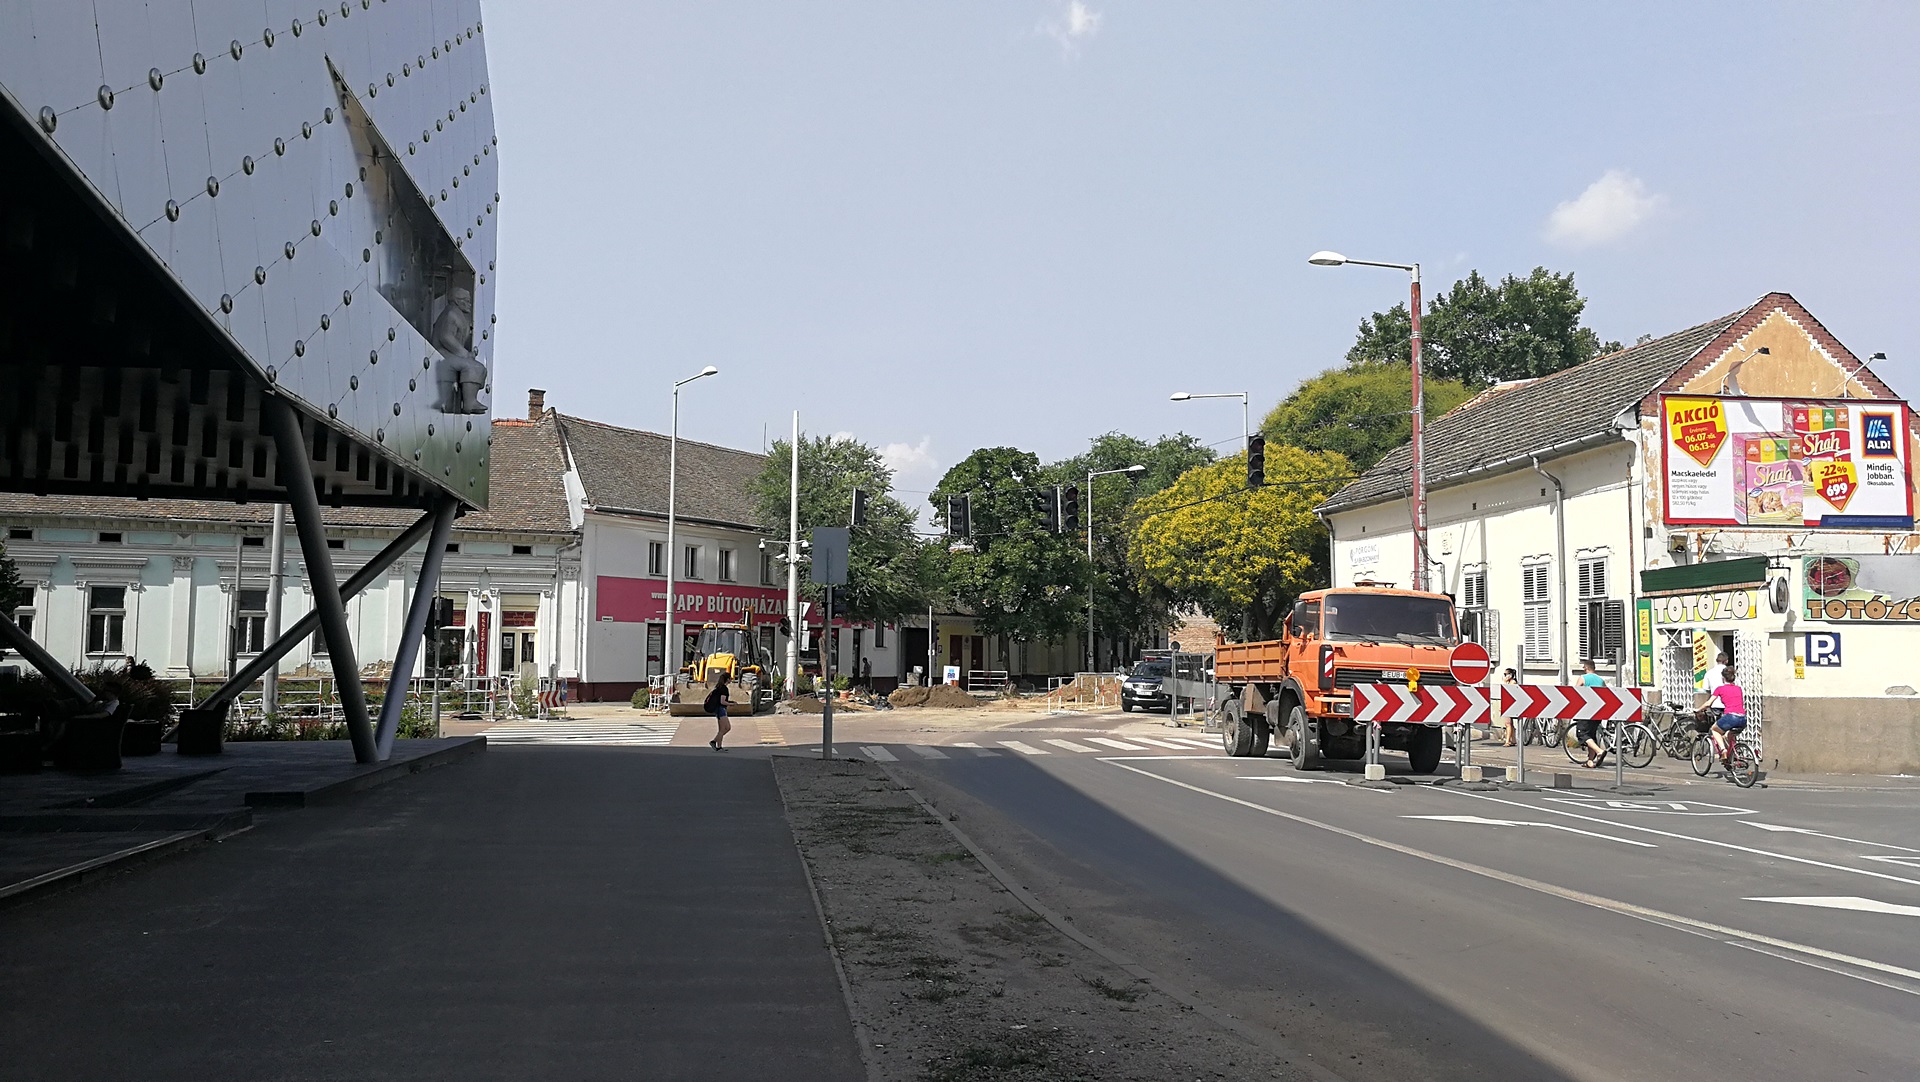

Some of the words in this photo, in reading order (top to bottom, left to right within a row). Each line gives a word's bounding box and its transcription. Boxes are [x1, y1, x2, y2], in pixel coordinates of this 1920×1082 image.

[1672, 400, 1719, 425] AKCIÓ
[1802, 432, 1840, 455] Shah
[1867, 440, 1891, 449] ALDI
[1753, 463, 1793, 487] Shah
[1866, 463, 1894, 473] Mindig.
[1826, 482, 1848, 497] 699
[1654, 589, 1750, 622] TOTÓZÓ
[1810, 634, 1836, 663] P
